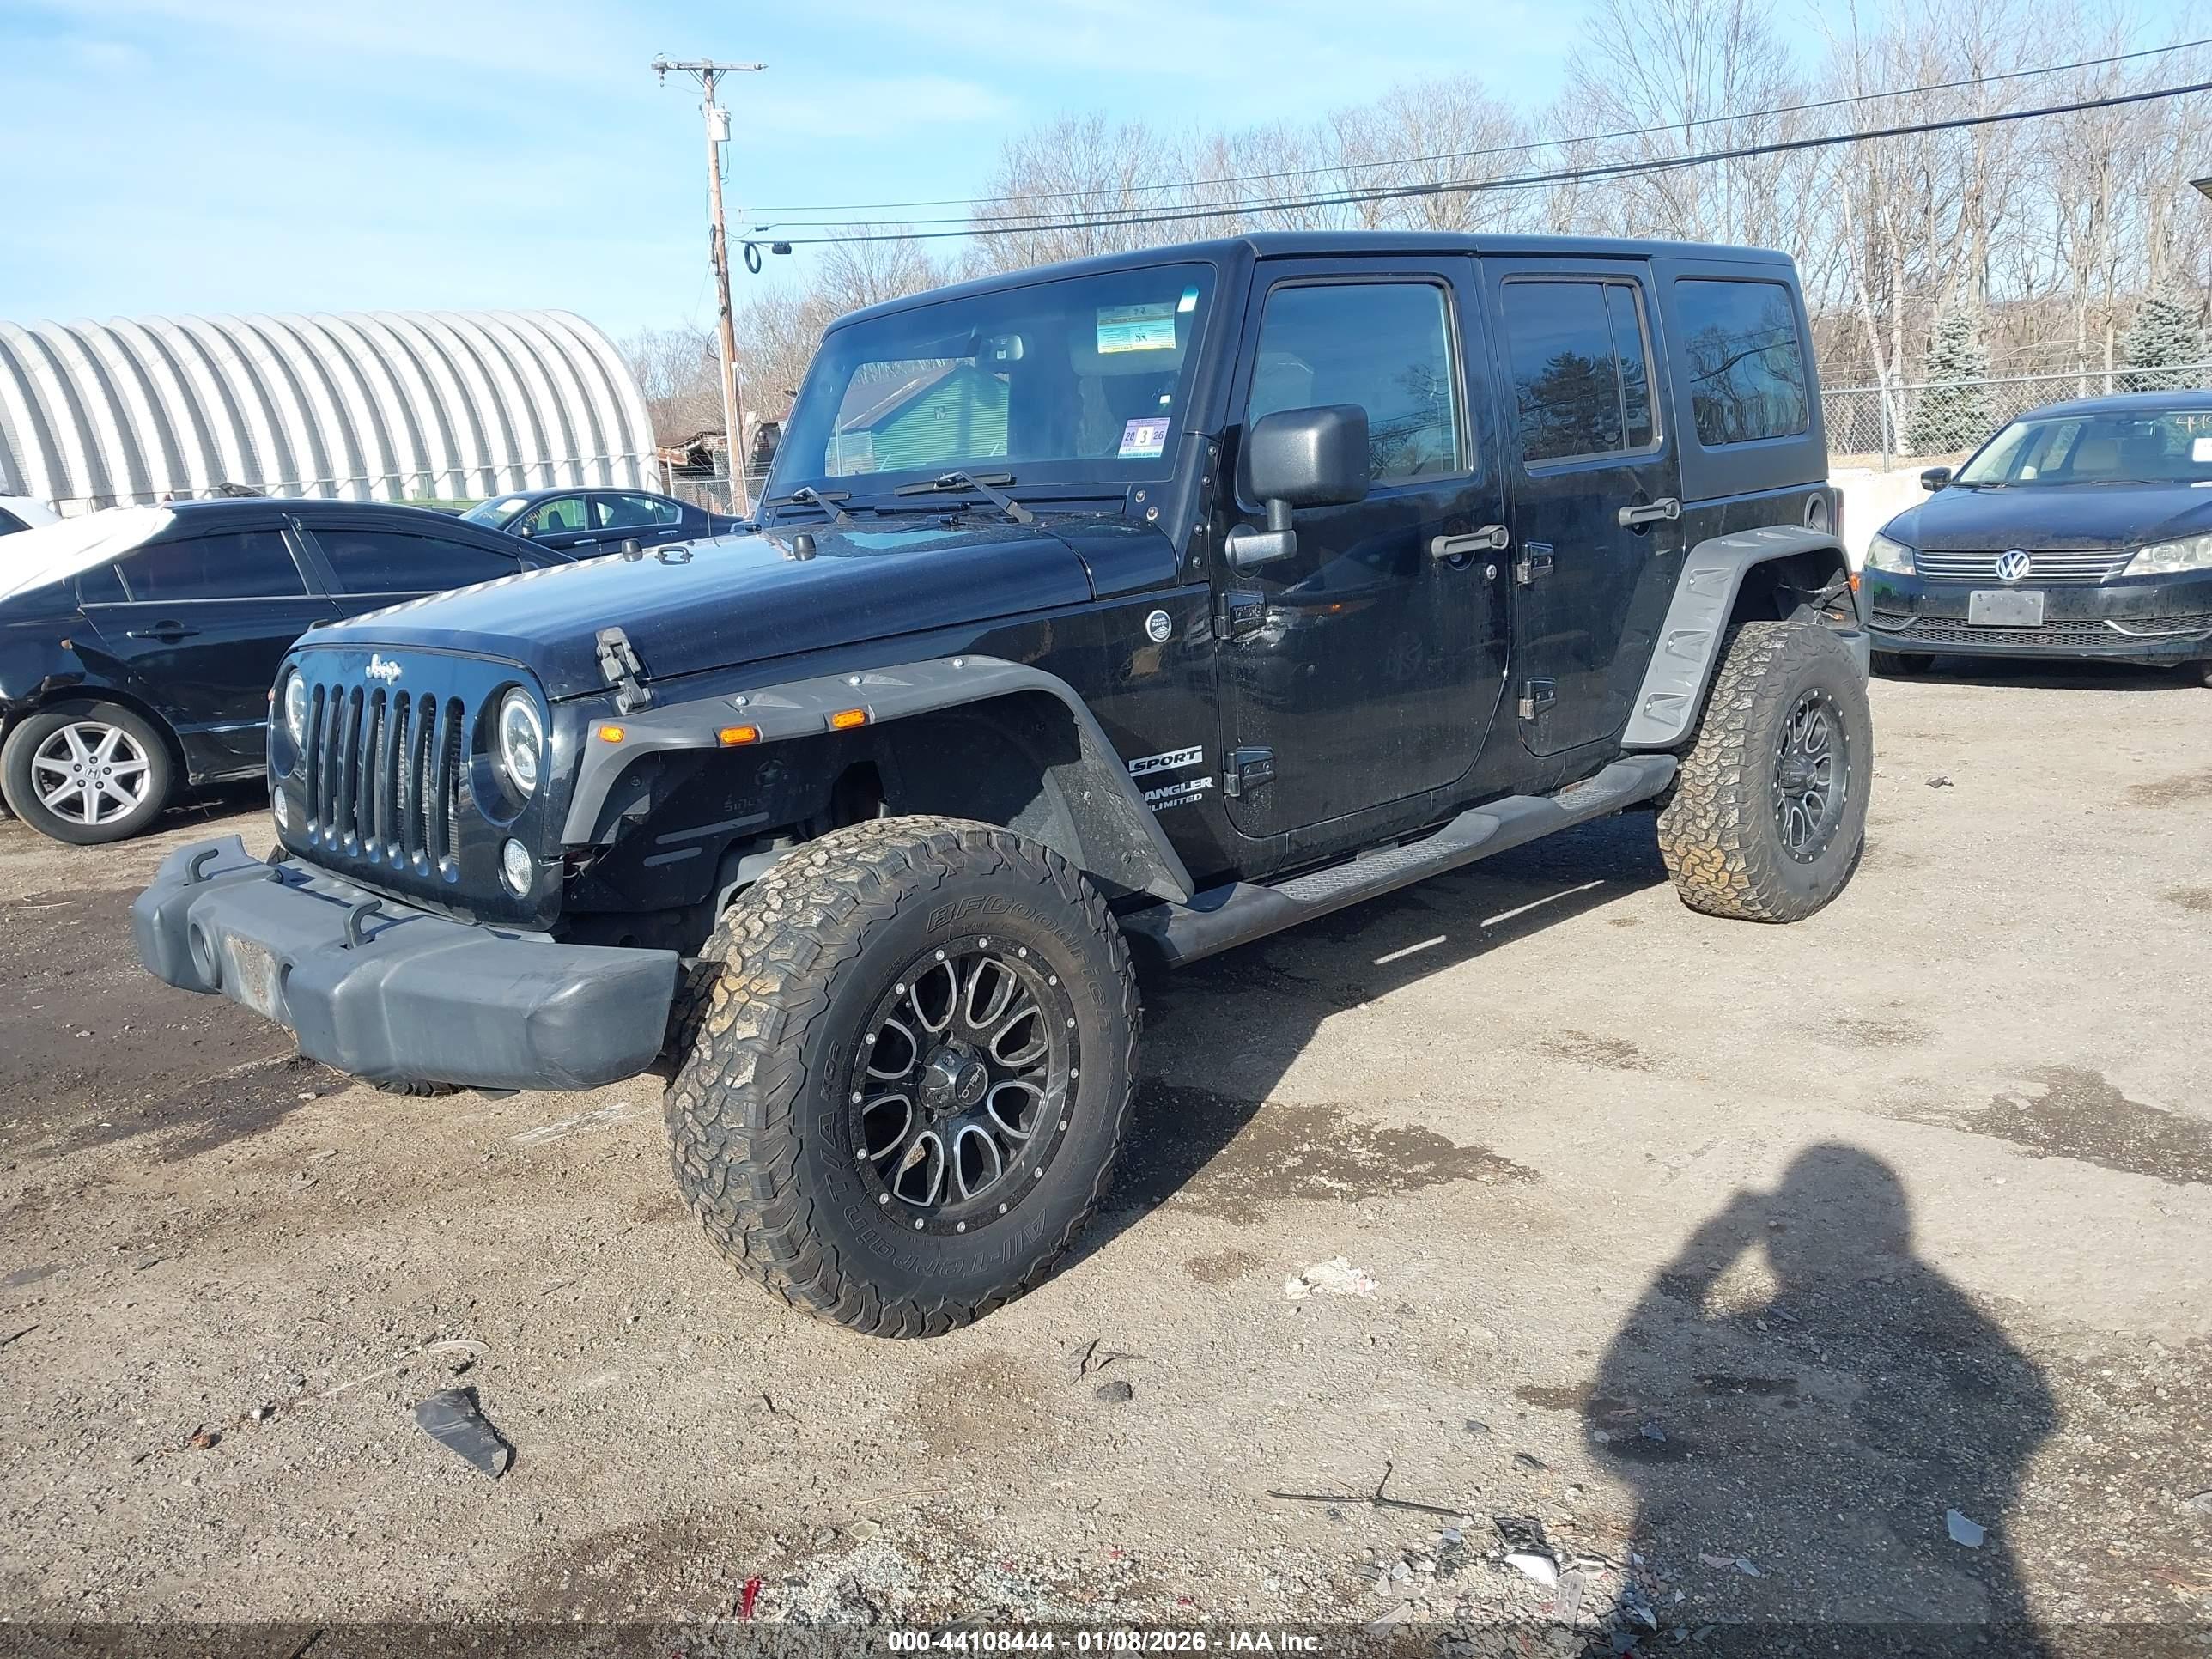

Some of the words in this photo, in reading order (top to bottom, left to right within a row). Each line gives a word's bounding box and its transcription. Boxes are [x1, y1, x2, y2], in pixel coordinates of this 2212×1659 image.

[1125, 432, 1135, 441] 20
[1140, 429, 1148, 444] 3
[1152, 430, 1164, 440] 26
[1129, 749, 1203, 774] SPORT
[1141, 776, 1215, 802] ANGLER
[1149, 793, 1203, 812] LIMITED
[926, 893, 1114, 1035] BFGoodrich
[961, 1066, 982, 1099] HELO
